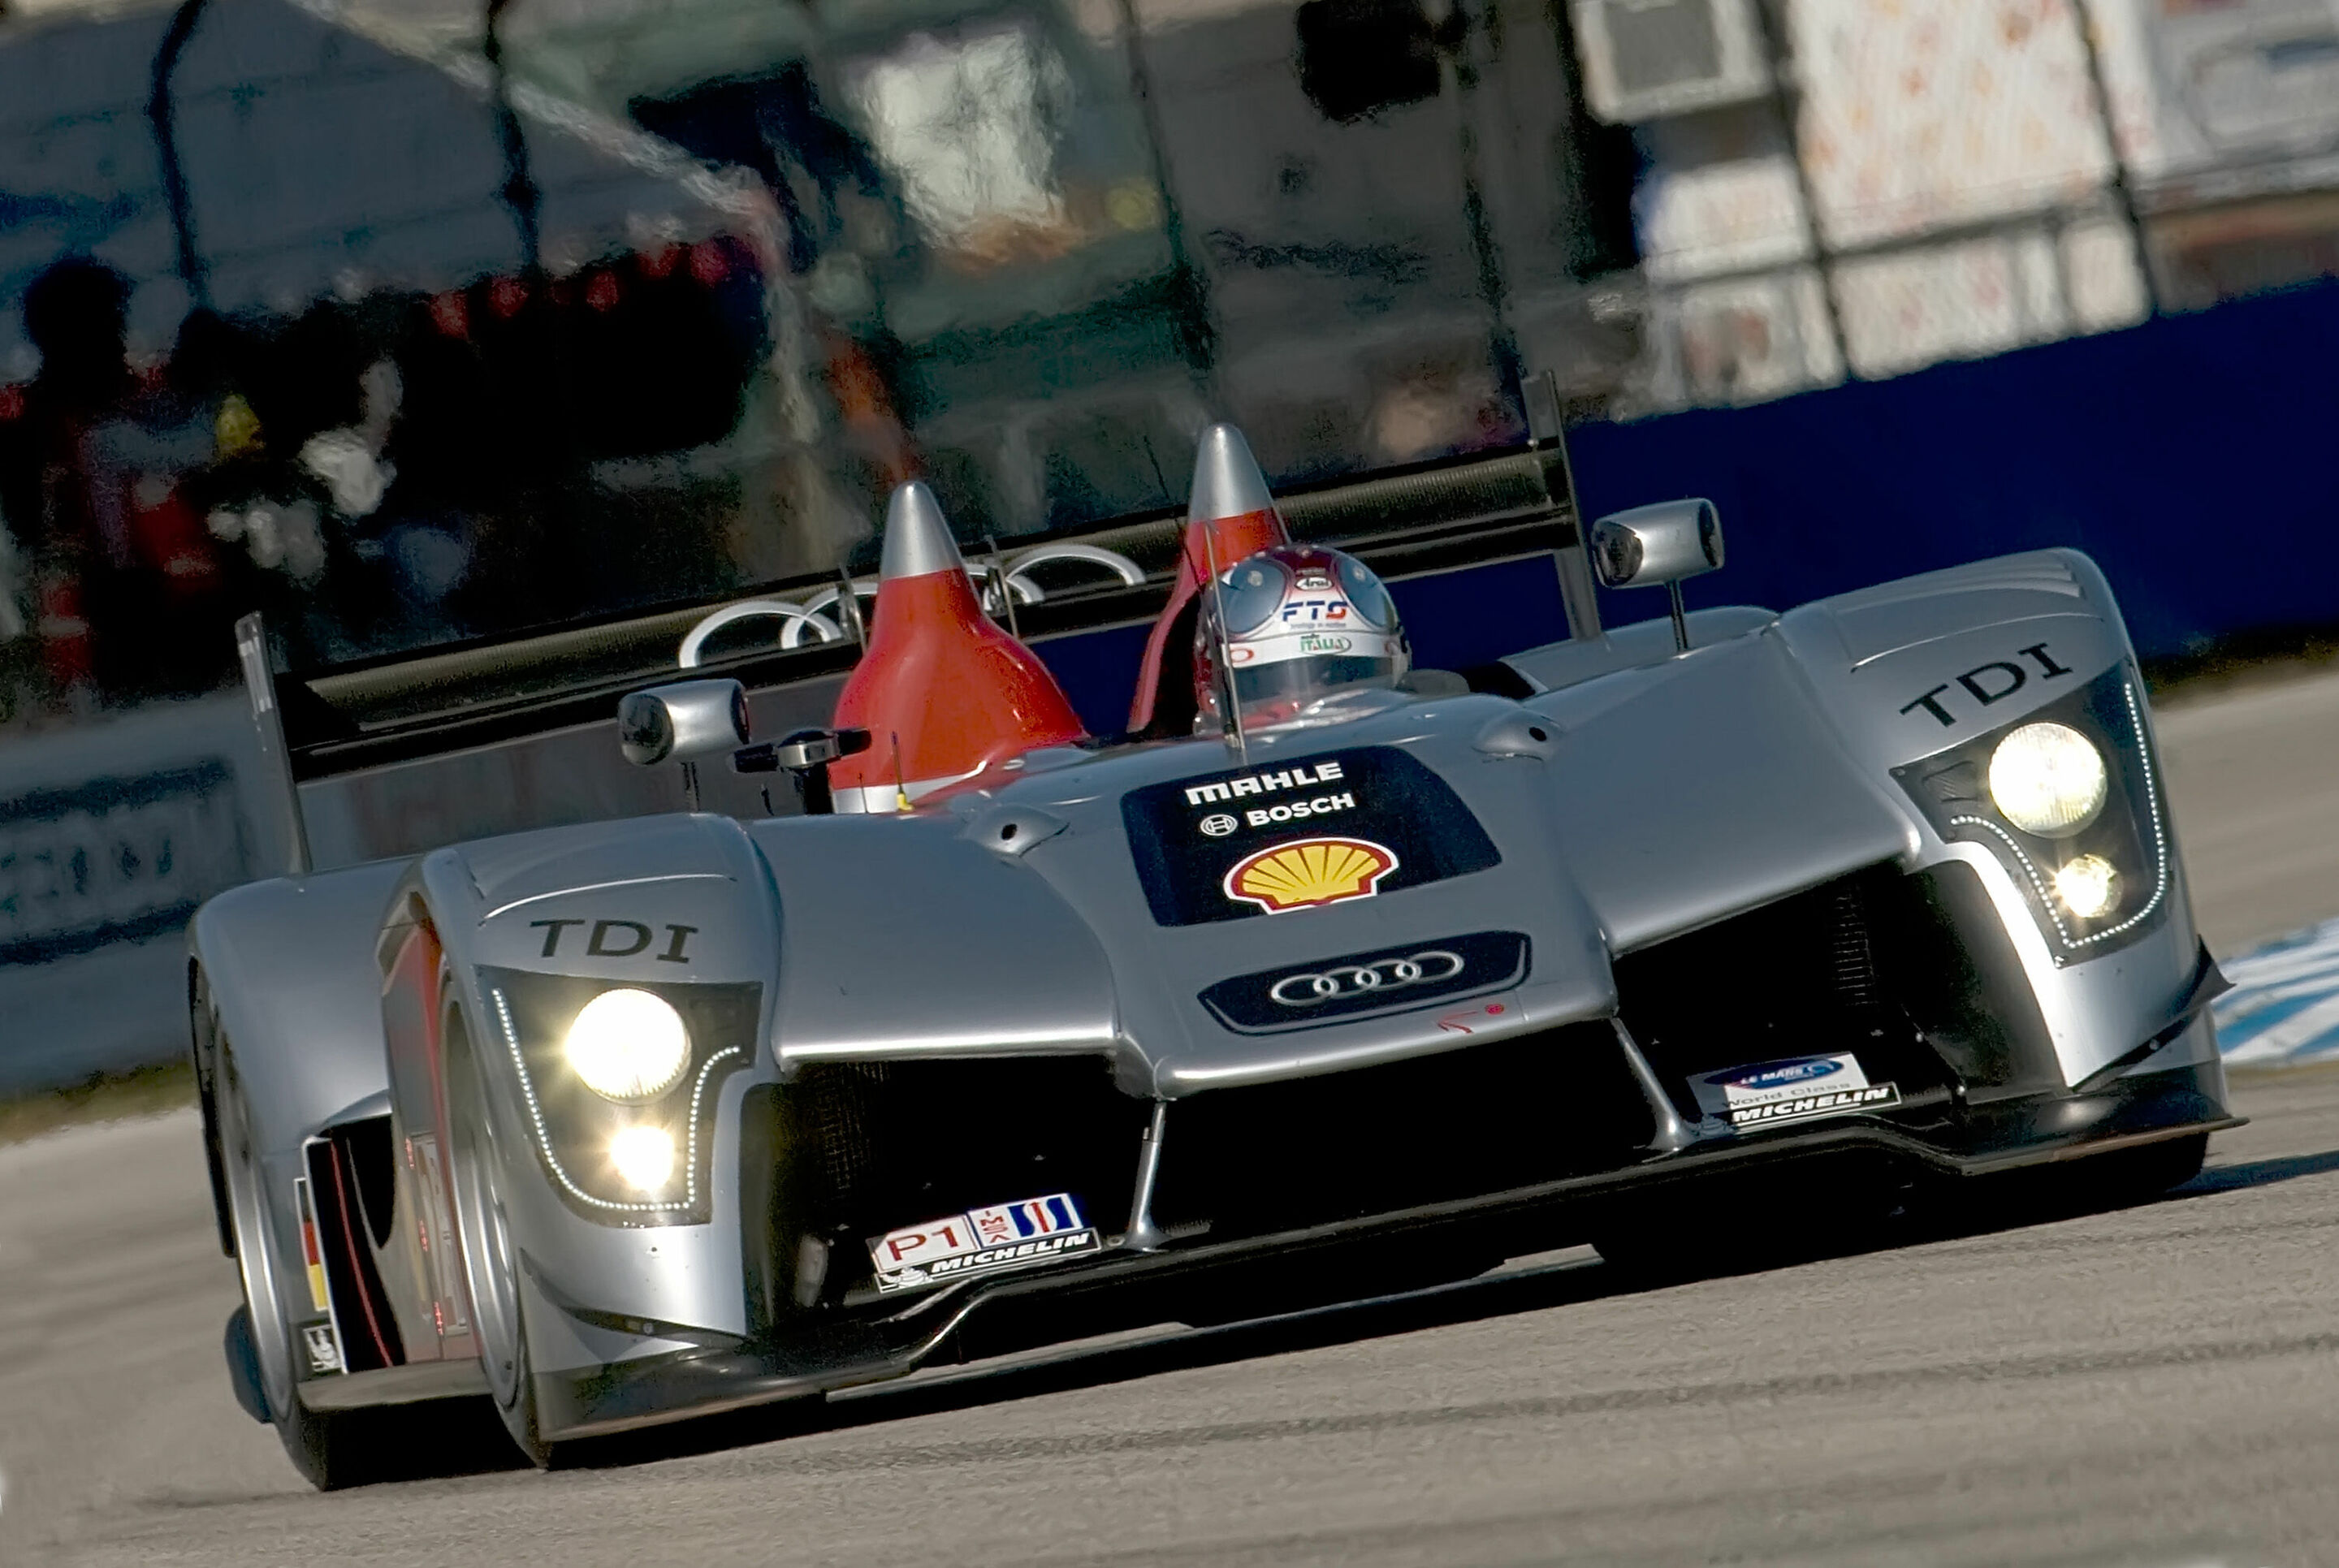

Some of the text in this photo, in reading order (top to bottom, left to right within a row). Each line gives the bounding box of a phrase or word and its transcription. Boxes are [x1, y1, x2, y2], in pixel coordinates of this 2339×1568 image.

[1899, 641, 2073, 728] TDI
[1184, 762, 1345, 806] MAHLE
[1247, 793, 1356, 827] BOSCH
[530, 918, 699, 964] TDI
[1762, 1066, 1804, 1082] MANS
[1790, 1082, 1851, 1096] Class
[1731, 1087, 1890, 1123] MICHELIN
[888, 1226, 959, 1262] P1
[931, 1232, 1090, 1273] MICHELIN
